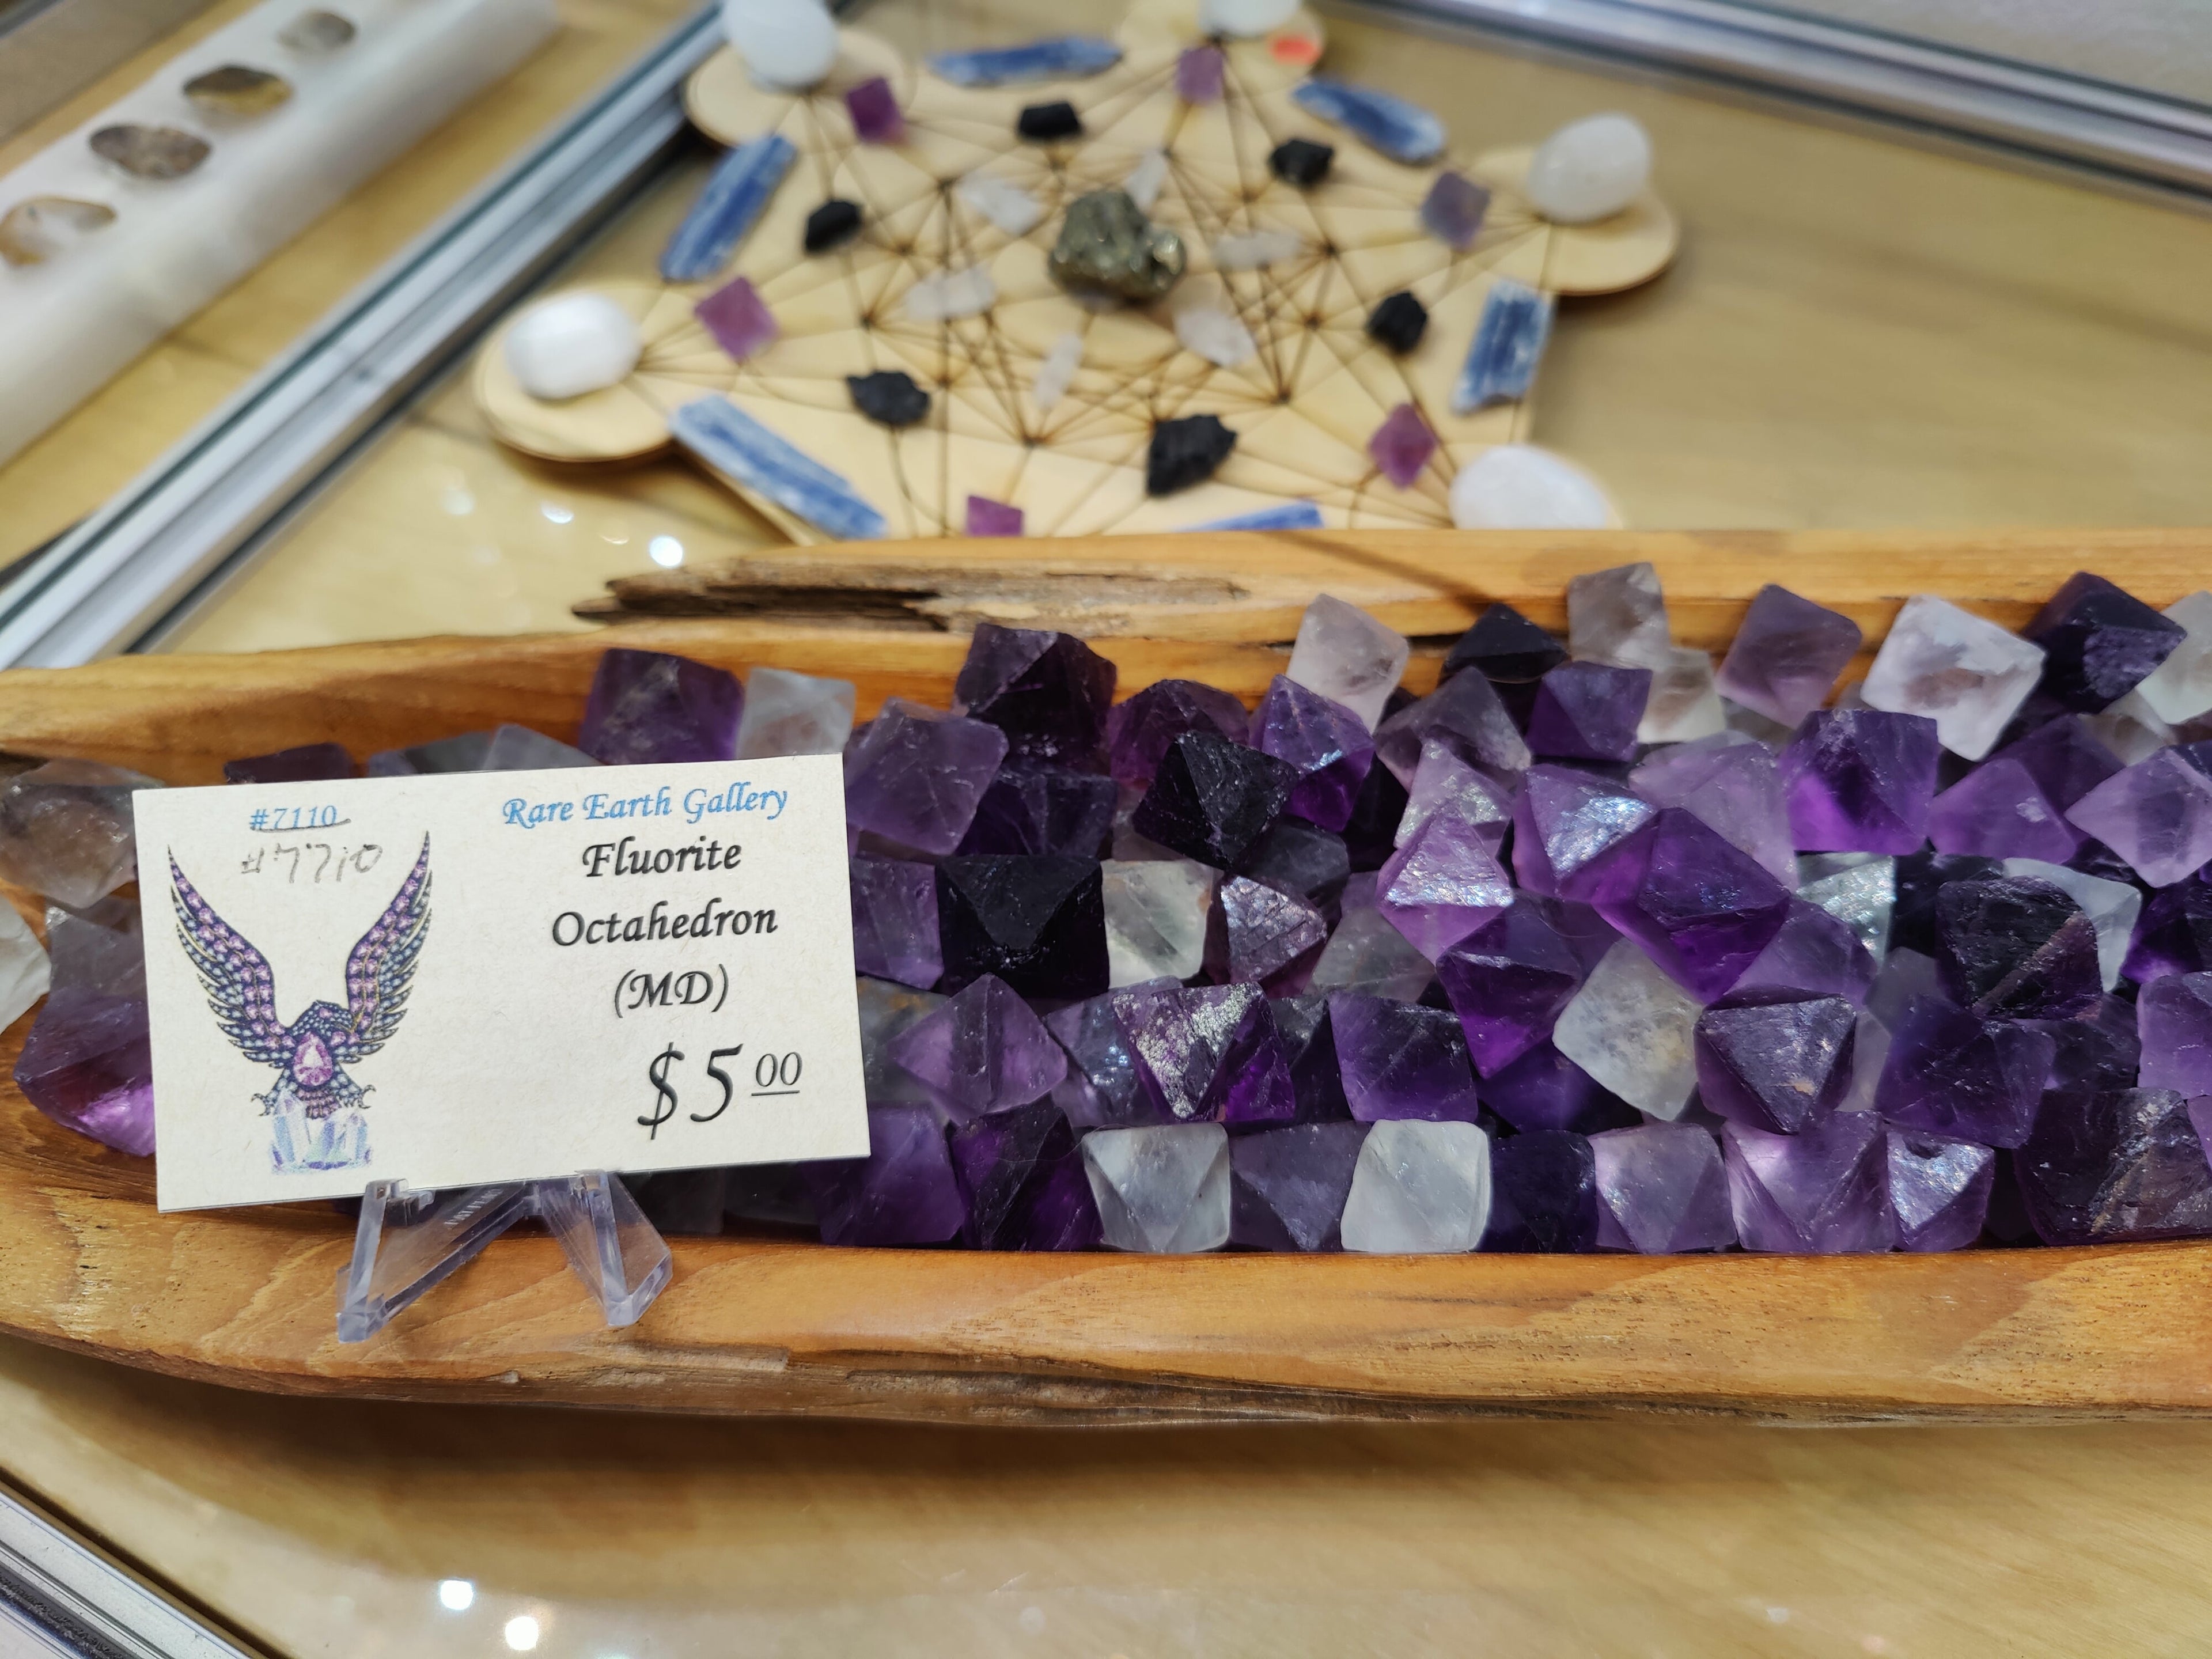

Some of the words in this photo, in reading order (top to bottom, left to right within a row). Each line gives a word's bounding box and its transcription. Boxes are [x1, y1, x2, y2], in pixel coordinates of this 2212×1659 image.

[249, 805, 338, 830] #7110
[503, 798, 574, 830] Rare
[582, 786, 673, 820] Earth
[684, 781, 788, 824] Gallery
[582, 835, 742, 877] Fluorite
[552, 897, 779, 946] Octahedron
[614, 964, 729, 1018] (MD)
